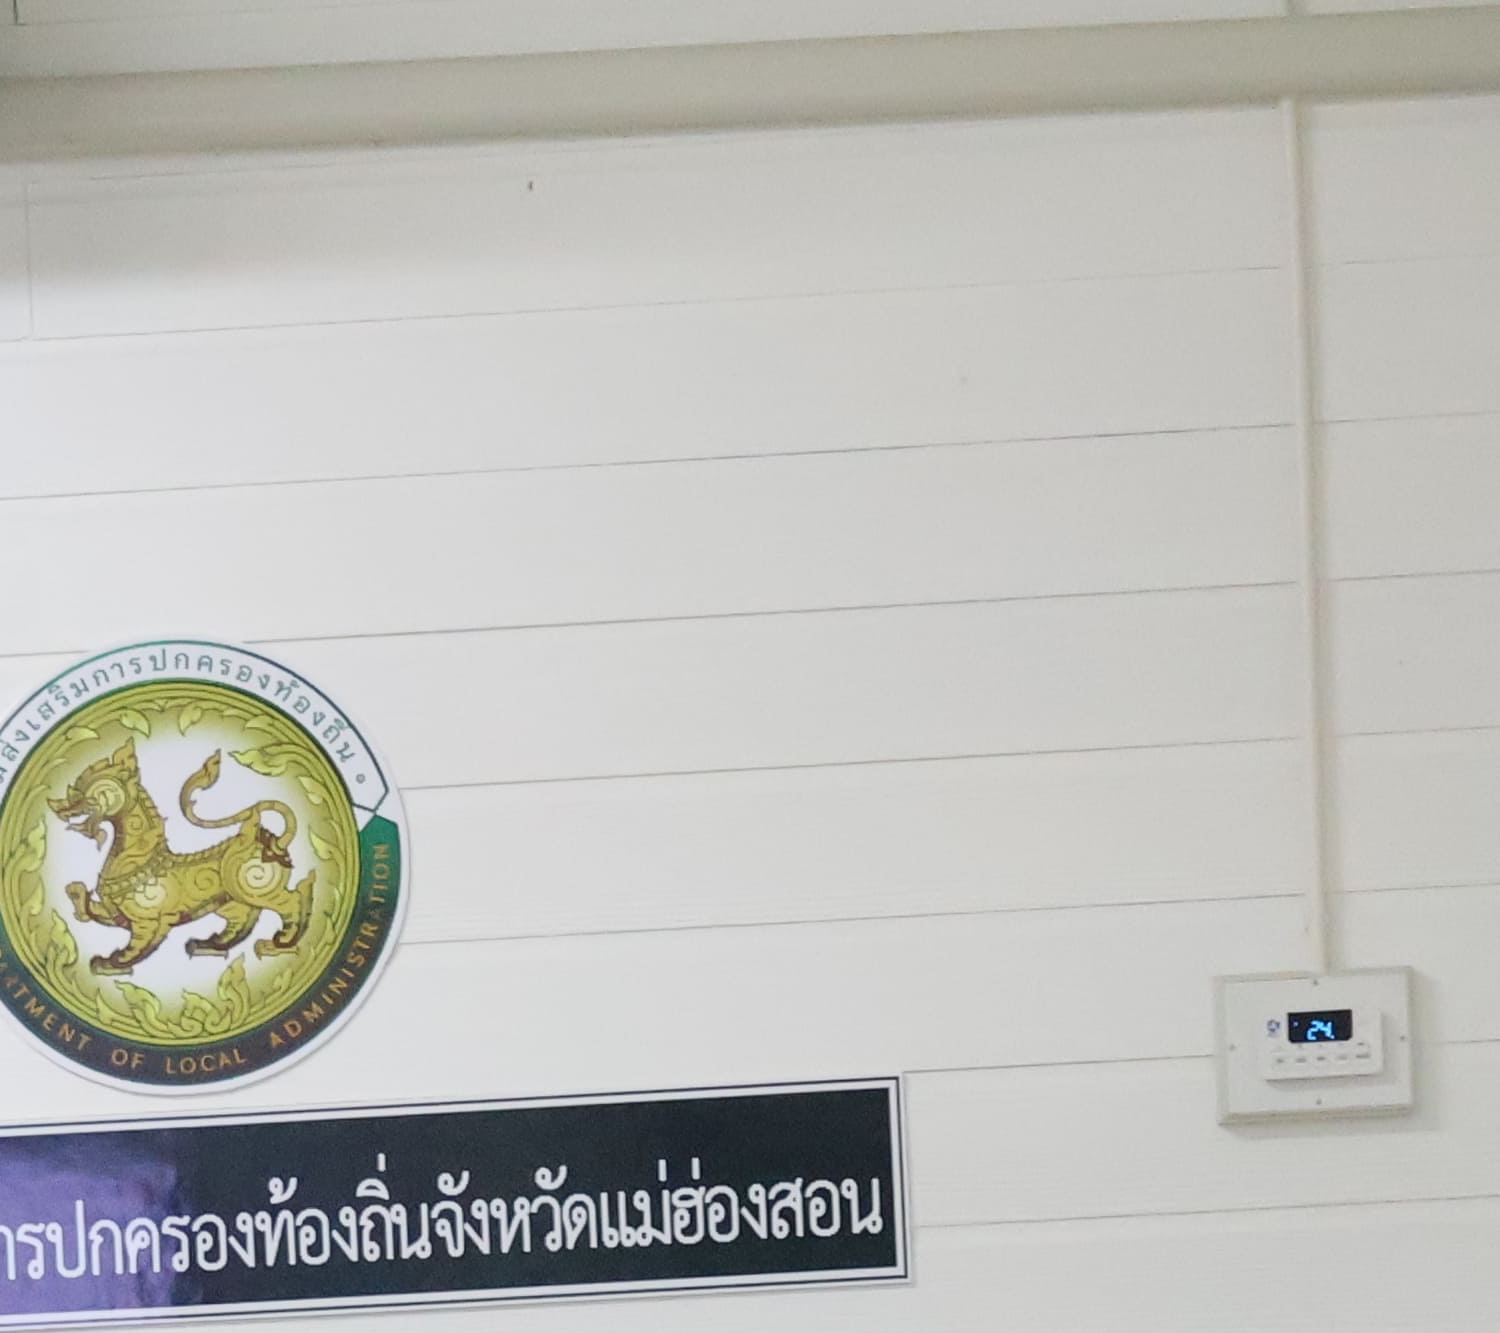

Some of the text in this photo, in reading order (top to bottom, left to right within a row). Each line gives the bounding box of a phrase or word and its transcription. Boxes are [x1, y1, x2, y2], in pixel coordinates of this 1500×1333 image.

[110, 1047, 146, 1071] OF
[165, 1049, 248, 1076] LOCAL
[268, 841, 392, 1050] ADMINISTRATION
